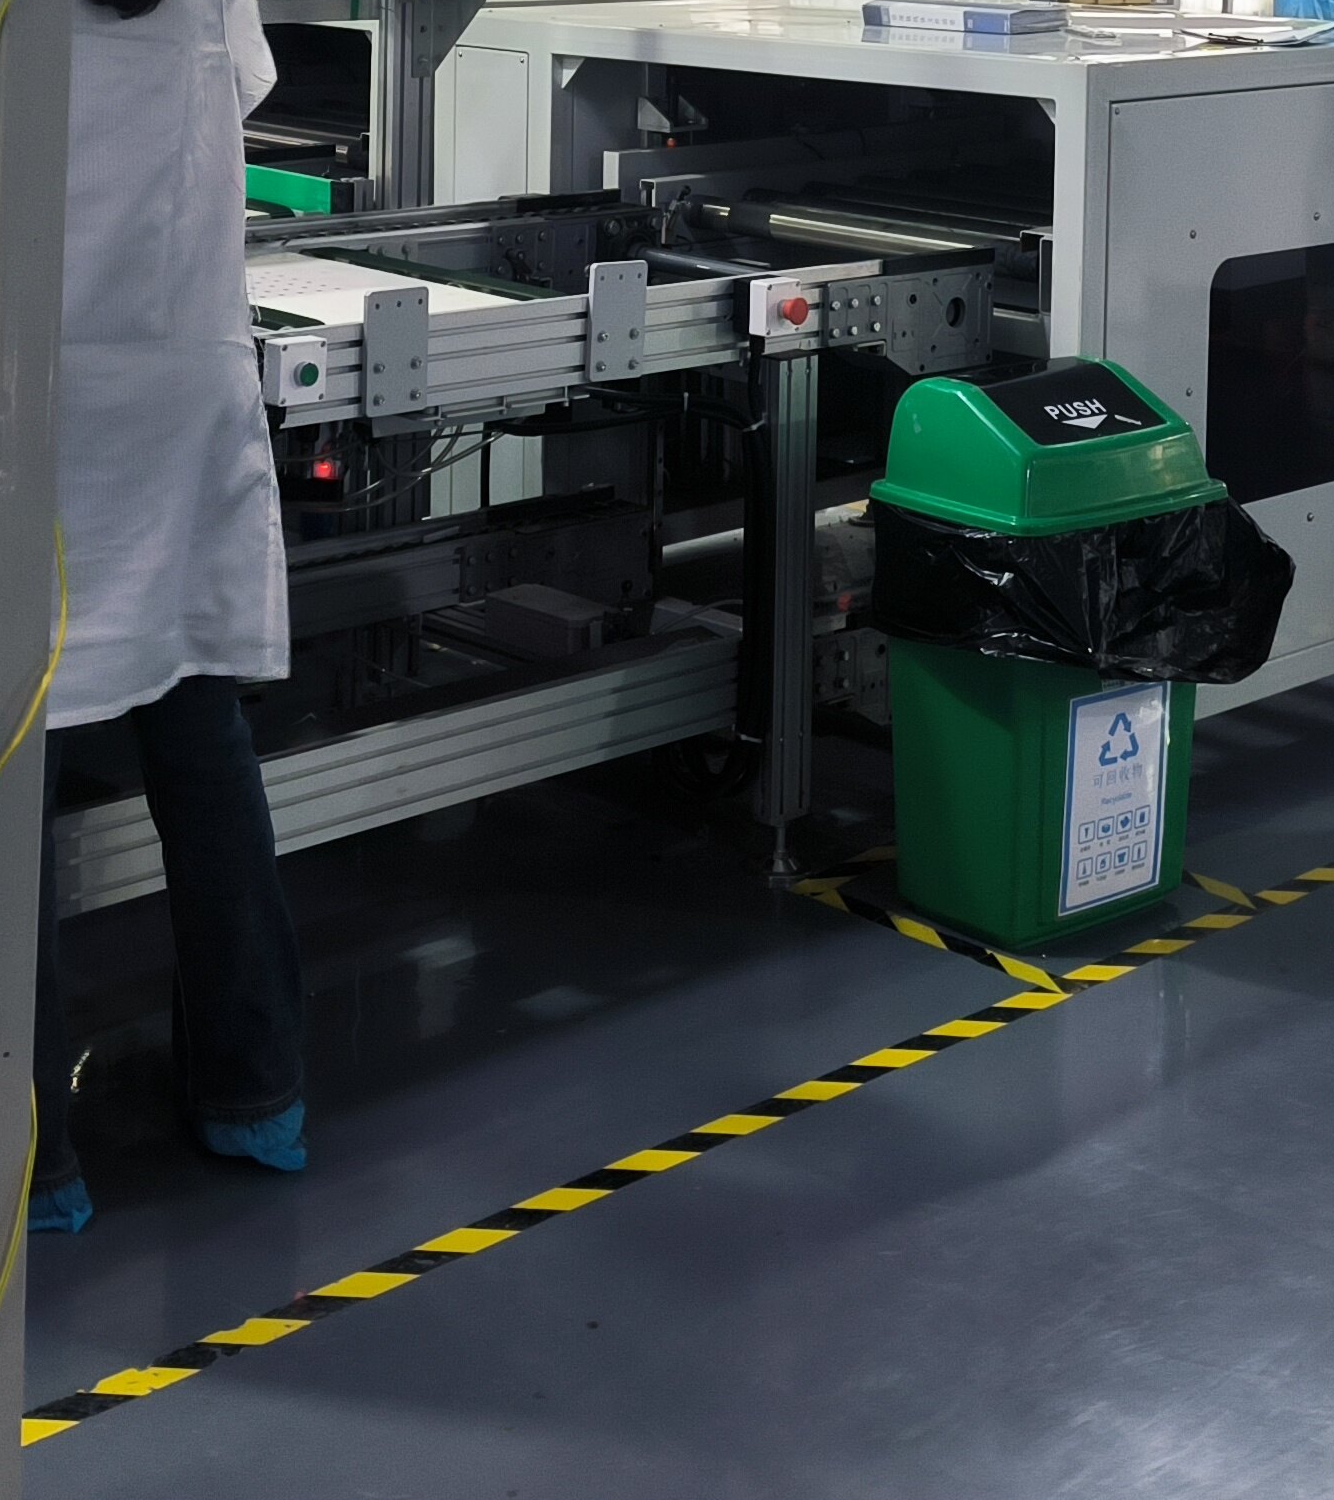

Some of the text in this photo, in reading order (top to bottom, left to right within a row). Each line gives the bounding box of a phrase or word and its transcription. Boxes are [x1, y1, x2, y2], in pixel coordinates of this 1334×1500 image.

[1043, 398, 1107, 421] PUSH
[1093, 763, 1143, 789] 可回收物
